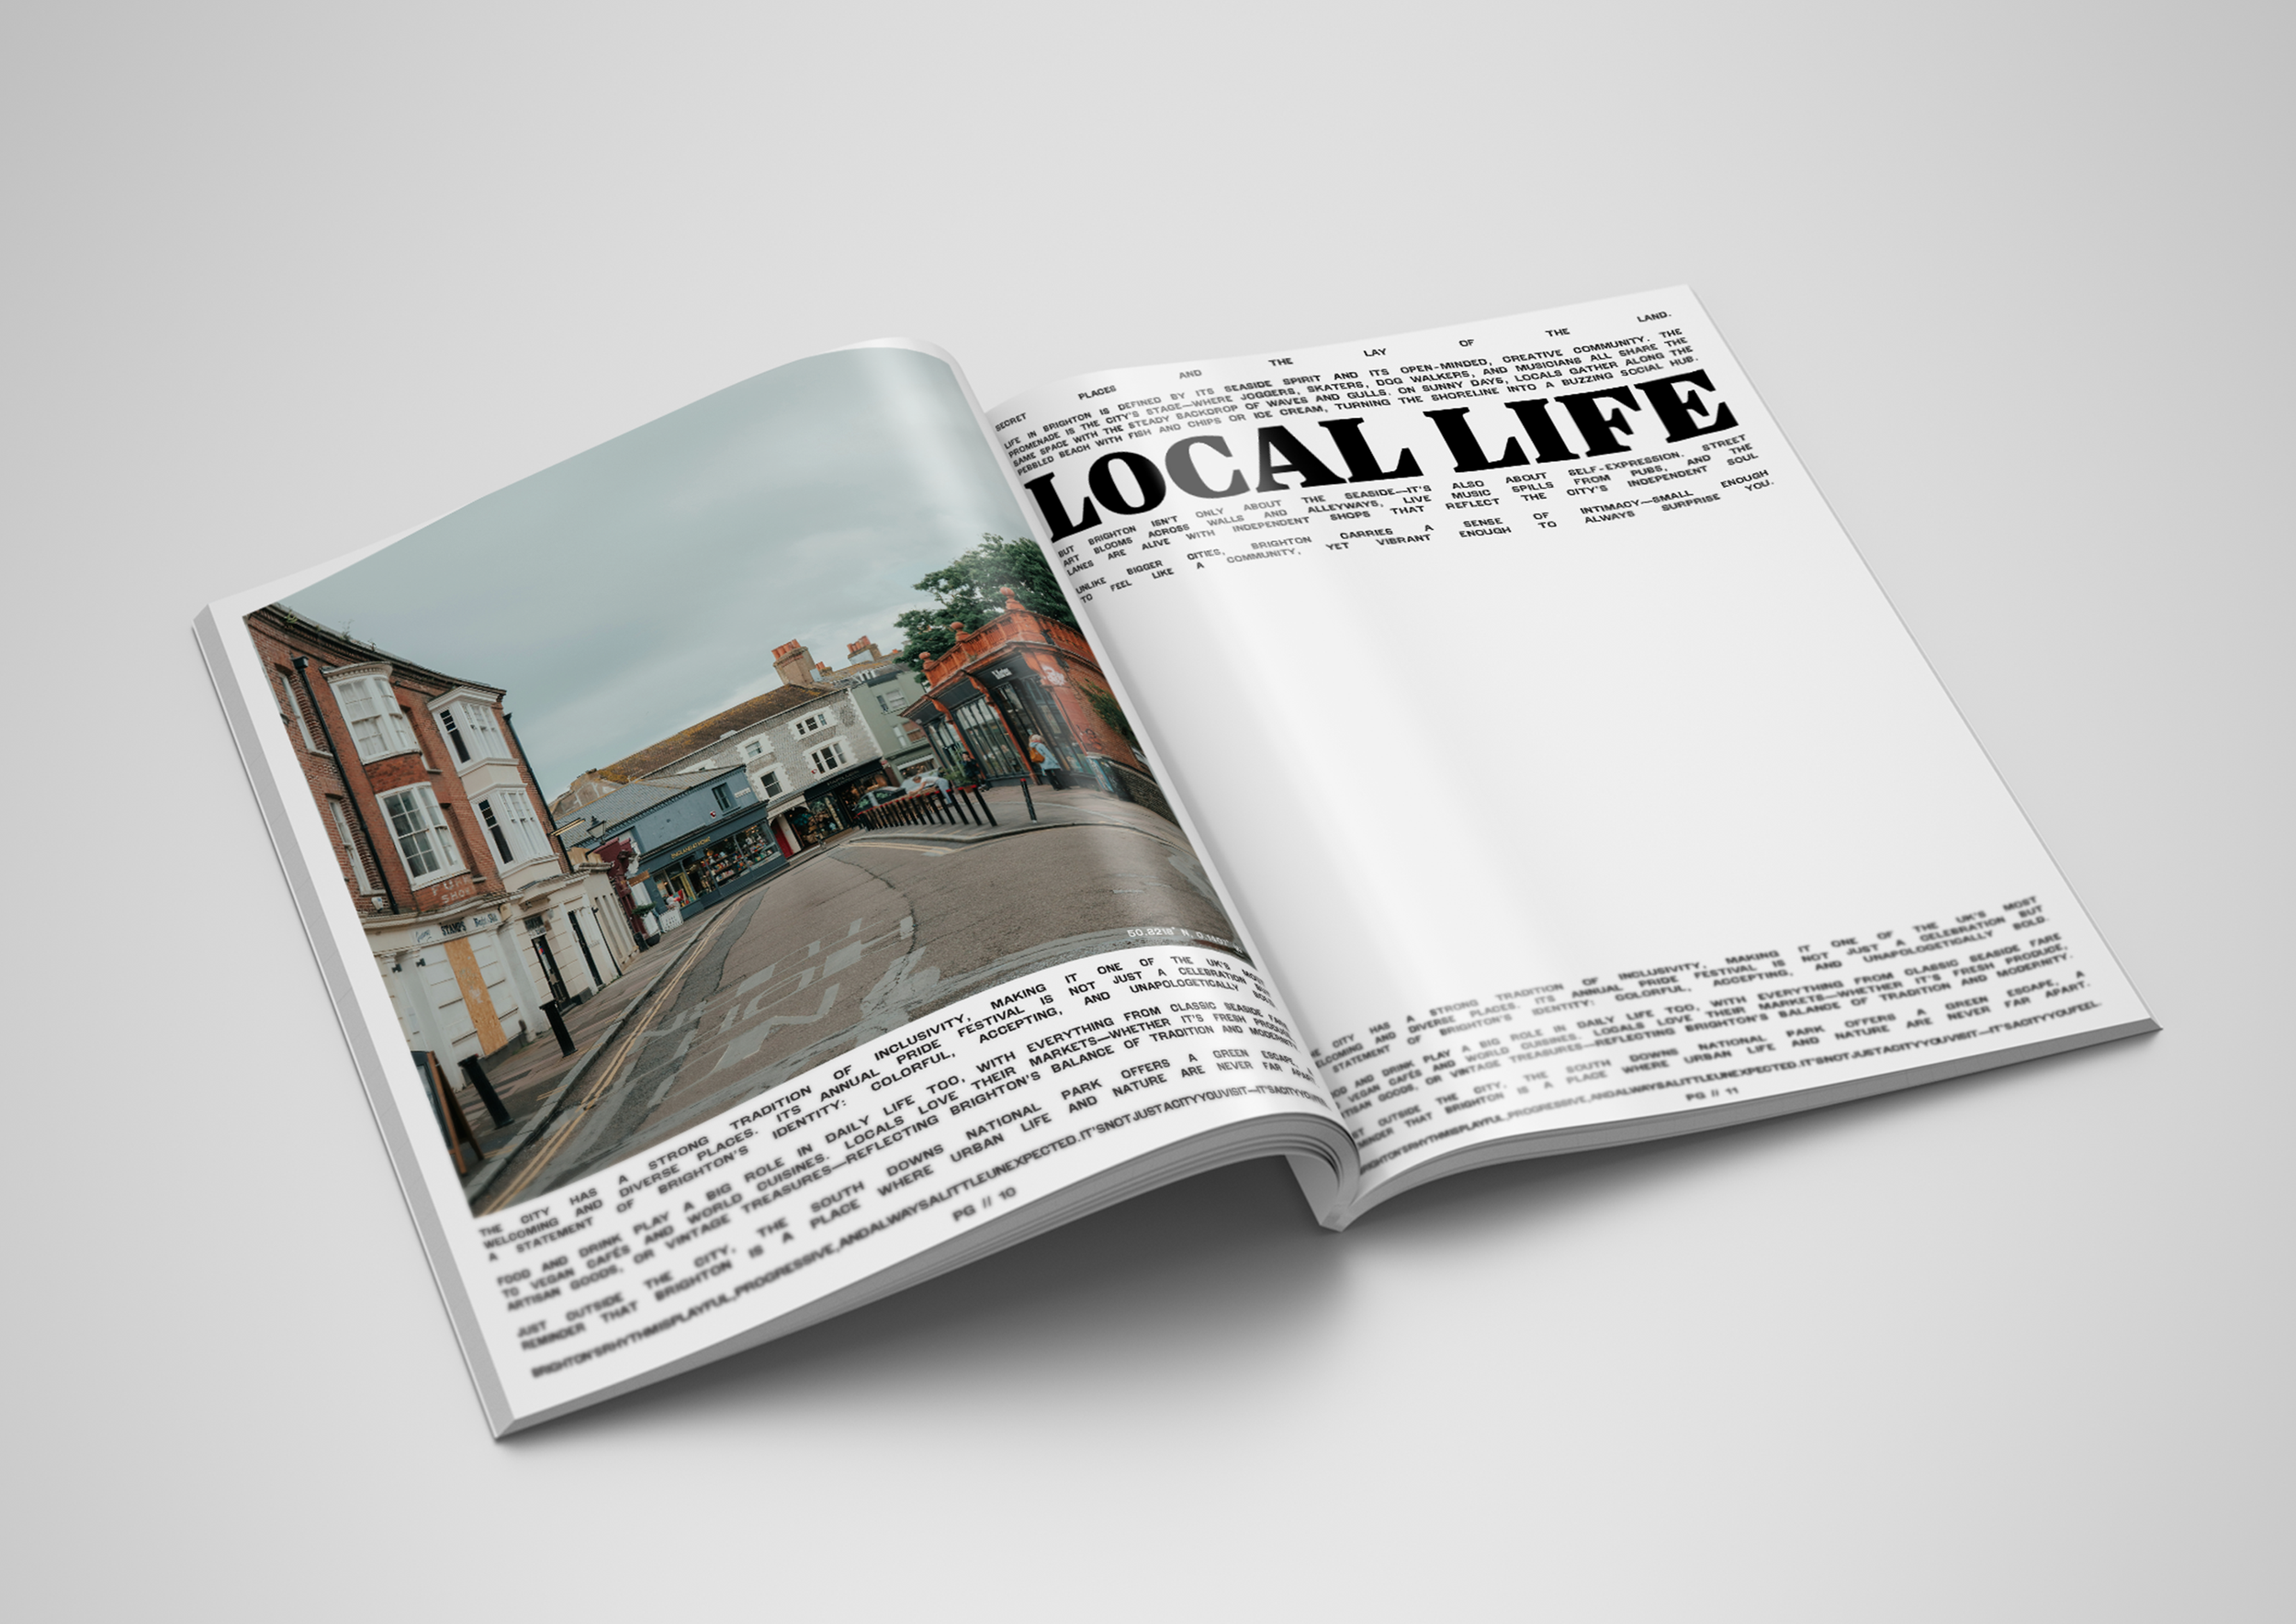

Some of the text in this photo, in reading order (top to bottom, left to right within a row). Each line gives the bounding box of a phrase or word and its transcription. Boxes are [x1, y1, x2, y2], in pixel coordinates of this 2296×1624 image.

[995, 311, 1671, 433] SECRET PLACES AND THE LAY OF THE LAND.
[1004, 328, 1683, 449] LIFE IN BRIGHTON IS DEFINED BY ITS SEASIDE SPIRIT AND ITS OPEN-MINDED, CREATIVE COMMUNITY. THE
[1007, 432, 1061, 458] PROMENADE
[1064, 427, 1075, 435] IS
[1079, 420, 1100, 431] THE
[1105, 411, 1140, 424] CITY'S
[1240, 388, 1300, 400] JOGGERS,
[1307, 381, 1369, 393] SKATERS,
[1375, 377, 1403, 387] DOG
[1409, 370, 1475, 383] WALKERS,
[1483, 367, 1508, 376] AND
[1514, 356, 1582, 372] MUSICIANS
[1591, 353, 1613, 362] ALL
[1618, 344, 1659, 357] SHARE
[1663, 336, 1688, 347] THE
[1024, 368, 1739, 544] LOCAL LIFE
[1058, 545, 1075, 558] BUT
[1087, 525, 1137, 546] BRIGHTON
[1151, 515, 1177, 527] ISN'T
[1195, 507, 1223, 518] ONLY
[1244, 500, 1281, 511] ABOUT
[1300, 495, 1326, 503] THE
[1452, 480, 1485, 490] ALSO
[1505, 472, 1547, 484] ABOUT
[1568, 451, 1684, 477] SELF-EXPRESSION.
[1702, 434, 1746, 452] STREET
[1063, 443, 1753, 567] ART BLOOMS ACROSS WALLS AND ALLEYWAYS, LIVE MUSIC SPILLS FROM PUBS, AND THE
[1075, 577, 1107, 593] UNLIKE
[1126, 559, 1164, 575] BIGGER
[1187, 548, 1225, 560] CITIES,
[1251, 536, 1312, 550] BRIGHTON
[1339, 528, 1393, 539] CARRIES
[1463, 517, 1503, 528] SENSE
[1533, 512, 1549, 520] OF
[1720, 470, 1769, 489] ENOUGH
[1081, 479, 1774, 603] TO FEEL LIKE A COMMUNITY, YET VIBRANT ENOUGH TO ALWAYS SURPRISE YOU.
[440, 920, 467, 936] STAMPS
[1332, 1033, 1355, 1049] CITY
[1368, 1021, 1390, 1034] HAS
[1406, 1015, 1415, 1023] A
[1429, 999, 1479, 1017] STRONG
[1495, 983, 1565, 1001] TRADITION
[1581, 976, 1598, 987] OF
[1617, 962, 1706, 981] INCLUSIVITY,
[1725, 950, 1780, 964] MAKING
[1797, 944, 1810, 953] IT
[1830, 937, 1858, 948] ONE
[1876, 930, 1893, 940] OF
[1913, 921, 1939, 932] THE
[1955, 910, 1986, 923] UK'S
[2002, 896, 2036, 911] MOST
[478, 1224, 502, 1237] THE
[520, 1206, 549, 1224] CITY
[569, 1188, 598, 1205] HAS
[618, 1175, 629, 1185] A
[648, 1136, 710, 1170] STRONG
[729, 1085, 812, 1130] TRADITION
[833, 1065, 851, 1080] OF
[874, 1013, 971, 1061] INCLUSIVITY,
[990, 984, 1047, 1009] MAKING
[1064, 973, 1077, 984] IT
[1097, 963, 1123, 975] ONE
[1139, 957, 1154, 967] OF
[1170, 956, 1194, 964] THE
[1206, 958, 1231, 971] UK'S
[483, 1217, 559, 1249] WELCOMING
[575, 1199, 603, 1217] AND
[618, 1164, 681, 1199] DIVERSE
[696, 1128, 759, 1161] PLACES.
[776, 1105, 802, 1122] ITS
[820, 1069, 881, 1102] ANNUAL
[896, 1039, 941, 1065] PRIDE
[957, 1006, 1025, 1038] FESTIVAL
[1040, 994, 1054, 1006] IS
[1068, 981, 1096, 996] NOT
[1113, 971, 1142, 985] JUST
[1157, 968, 1167, 976] A
[1177, 967, 1247, 985] CELEBRATION
[489, 1252, 499, 1262] A
[516, 1216, 592, 1253] STATEMENT
[615, 1198, 634, 1213] OF
[658, 1145, 749, 1195] BRIGHTON'S
[771, 1100, 846, 1140] IDENTITY:
[871, 1052, 955, 1091] COLORFUL,
[980, 1007, 1063, 1043] ACCEPTING,
[1084, 991, 1110, 1006] AND
[1129, 978, 1234, 994] UNAPOLOGETICALLY
[951, 1204, 976, 1222] PG
